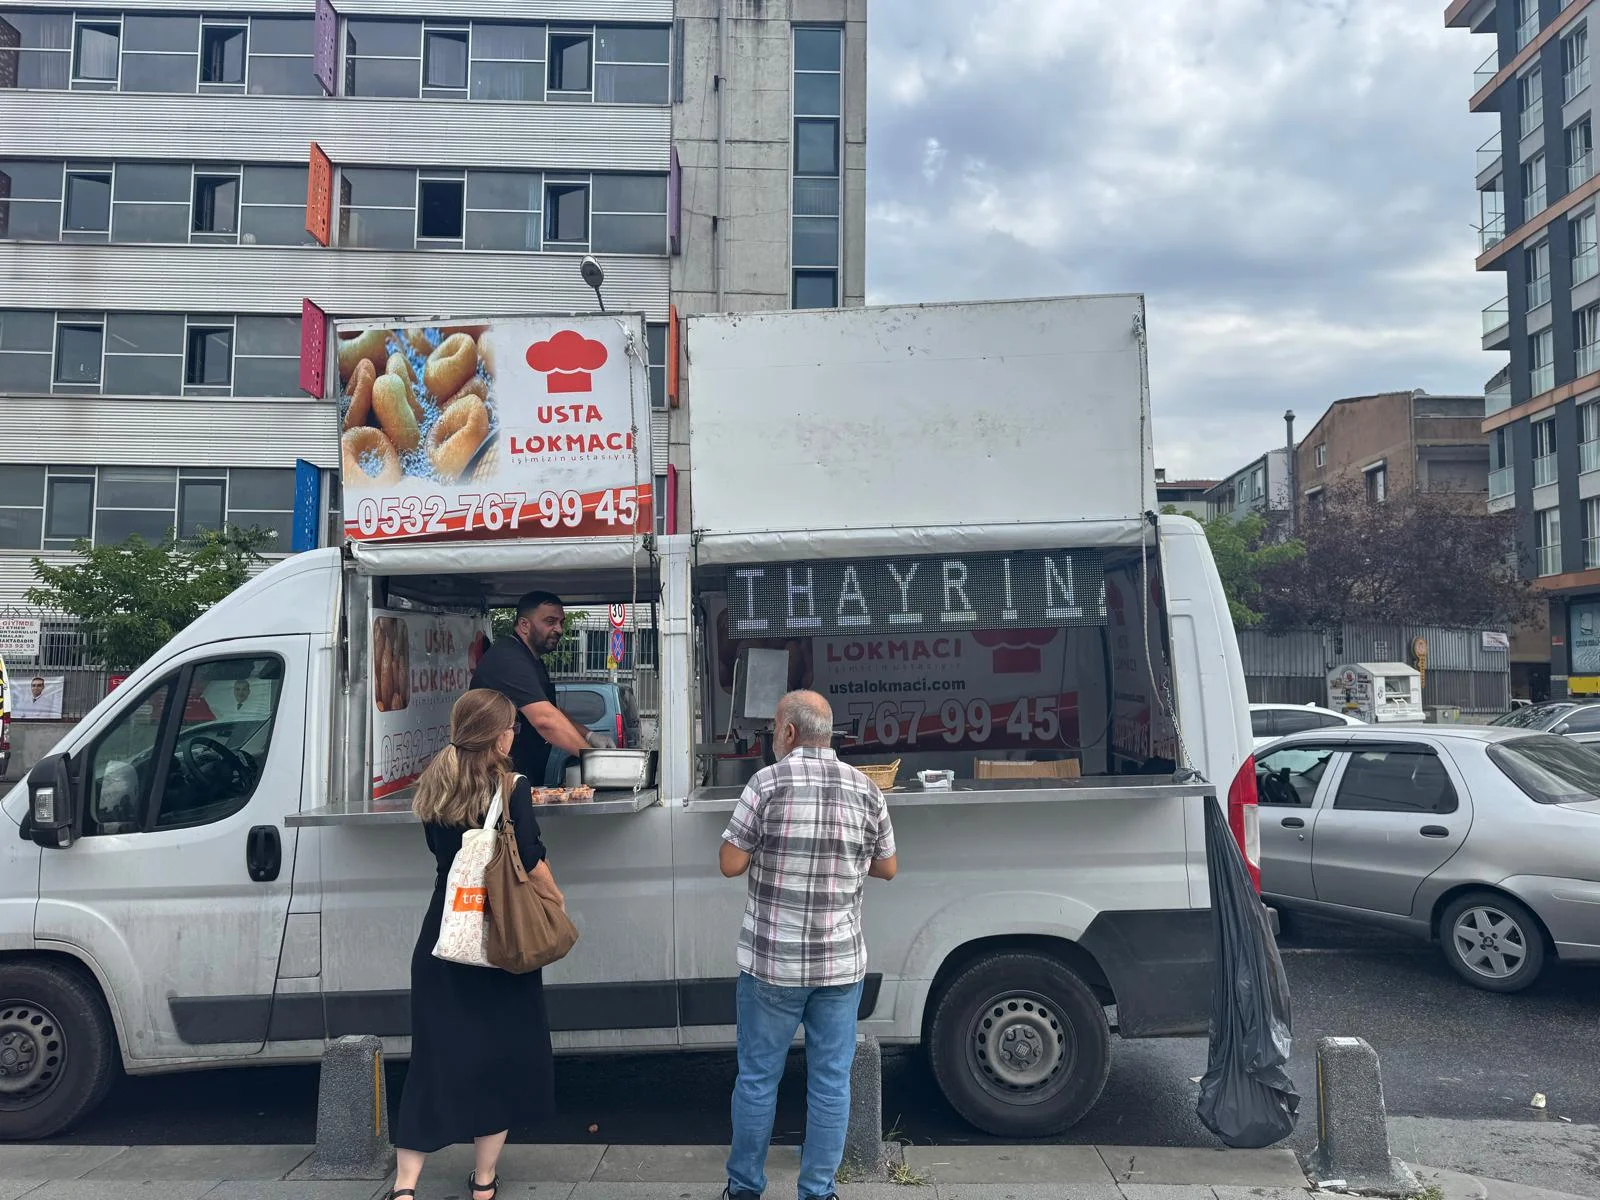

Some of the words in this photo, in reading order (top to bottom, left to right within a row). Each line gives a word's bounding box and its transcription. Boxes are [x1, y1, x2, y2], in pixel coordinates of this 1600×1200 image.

[537, 404, 603, 424] USTA
[510, 432, 634, 454] LOKMACI
[357, 495, 447, 535] 0532
[458, 492, 527, 531] 767
[538, 490, 583, 528] 99
[594, 488, 639, 526] 45
[612, 604, 622, 618] 30
[425, 628, 455, 655] USTA
[826, 638, 962, 662] LOKMACI
[829, 678, 966, 694] ustalokmaci.com
[848, 700, 926, 746] 767
[940, 698, 992, 744] 99
[1006, 697, 1059, 741] 45
